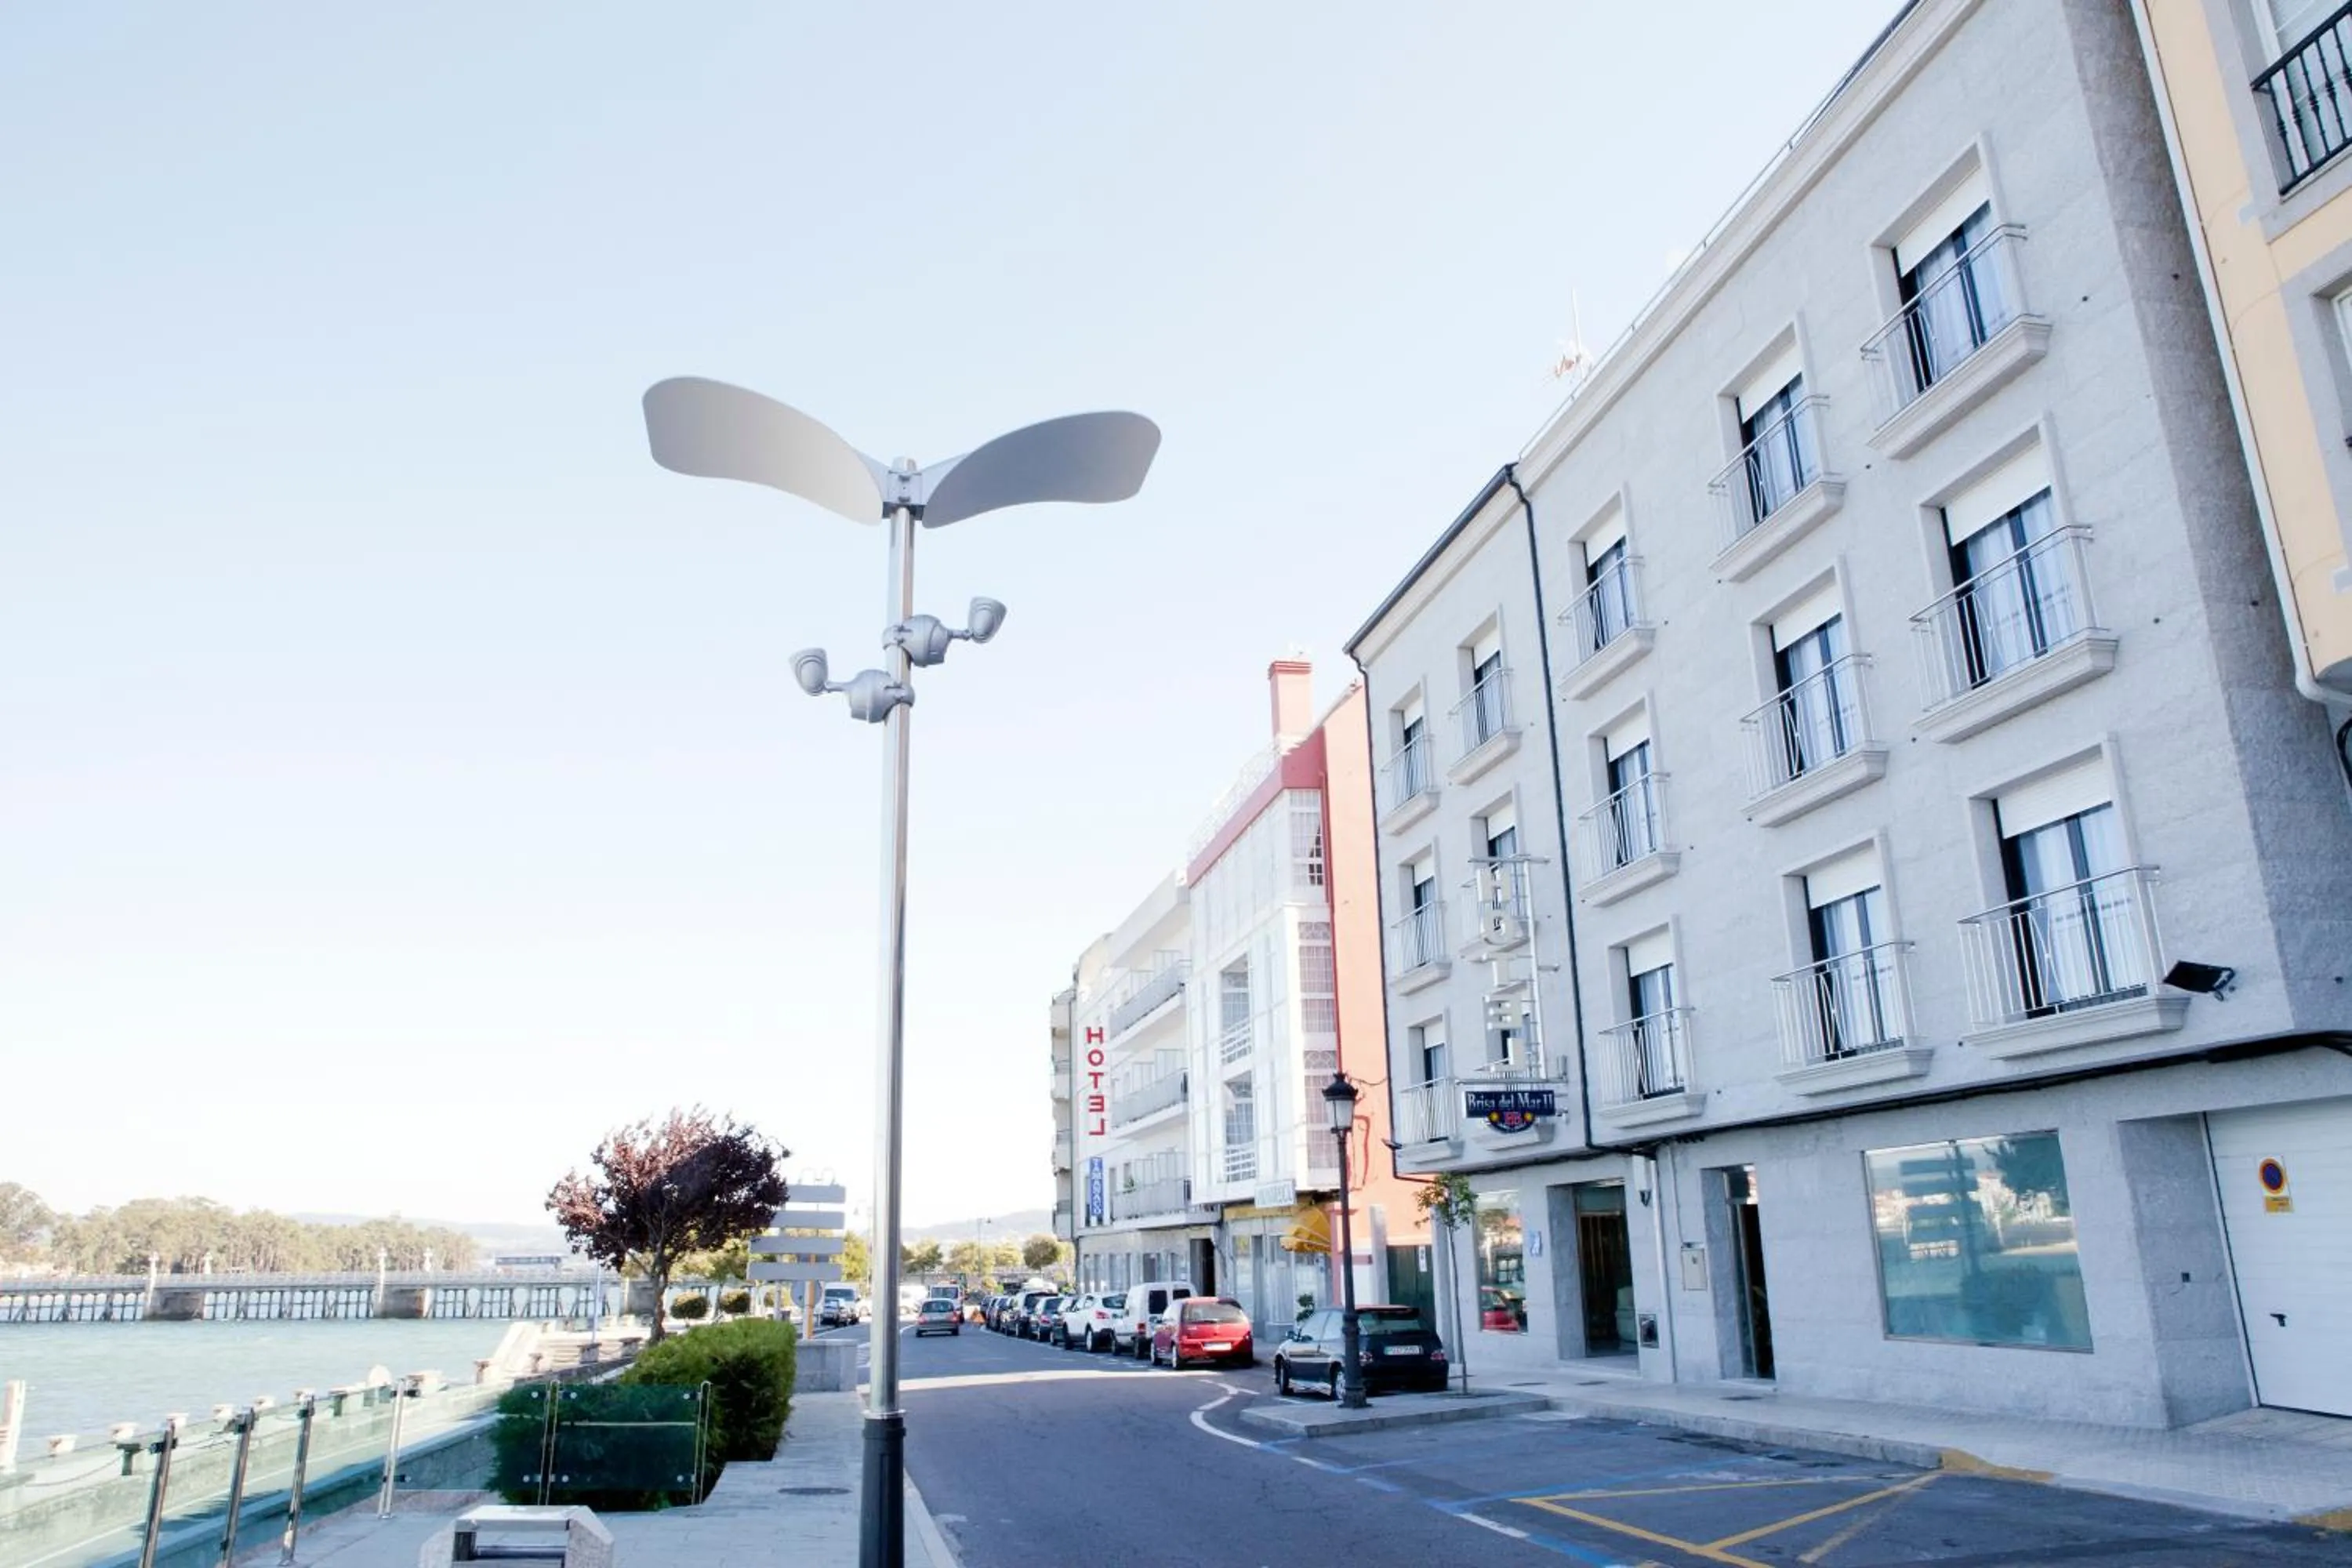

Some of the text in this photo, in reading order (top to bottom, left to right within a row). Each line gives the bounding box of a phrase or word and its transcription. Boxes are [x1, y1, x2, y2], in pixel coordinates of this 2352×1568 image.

[1468, 1093, 1495, 1110] Brisa
[1498, 1094, 1514, 1108] del
[1517, 1093, 1541, 1109] Mar
